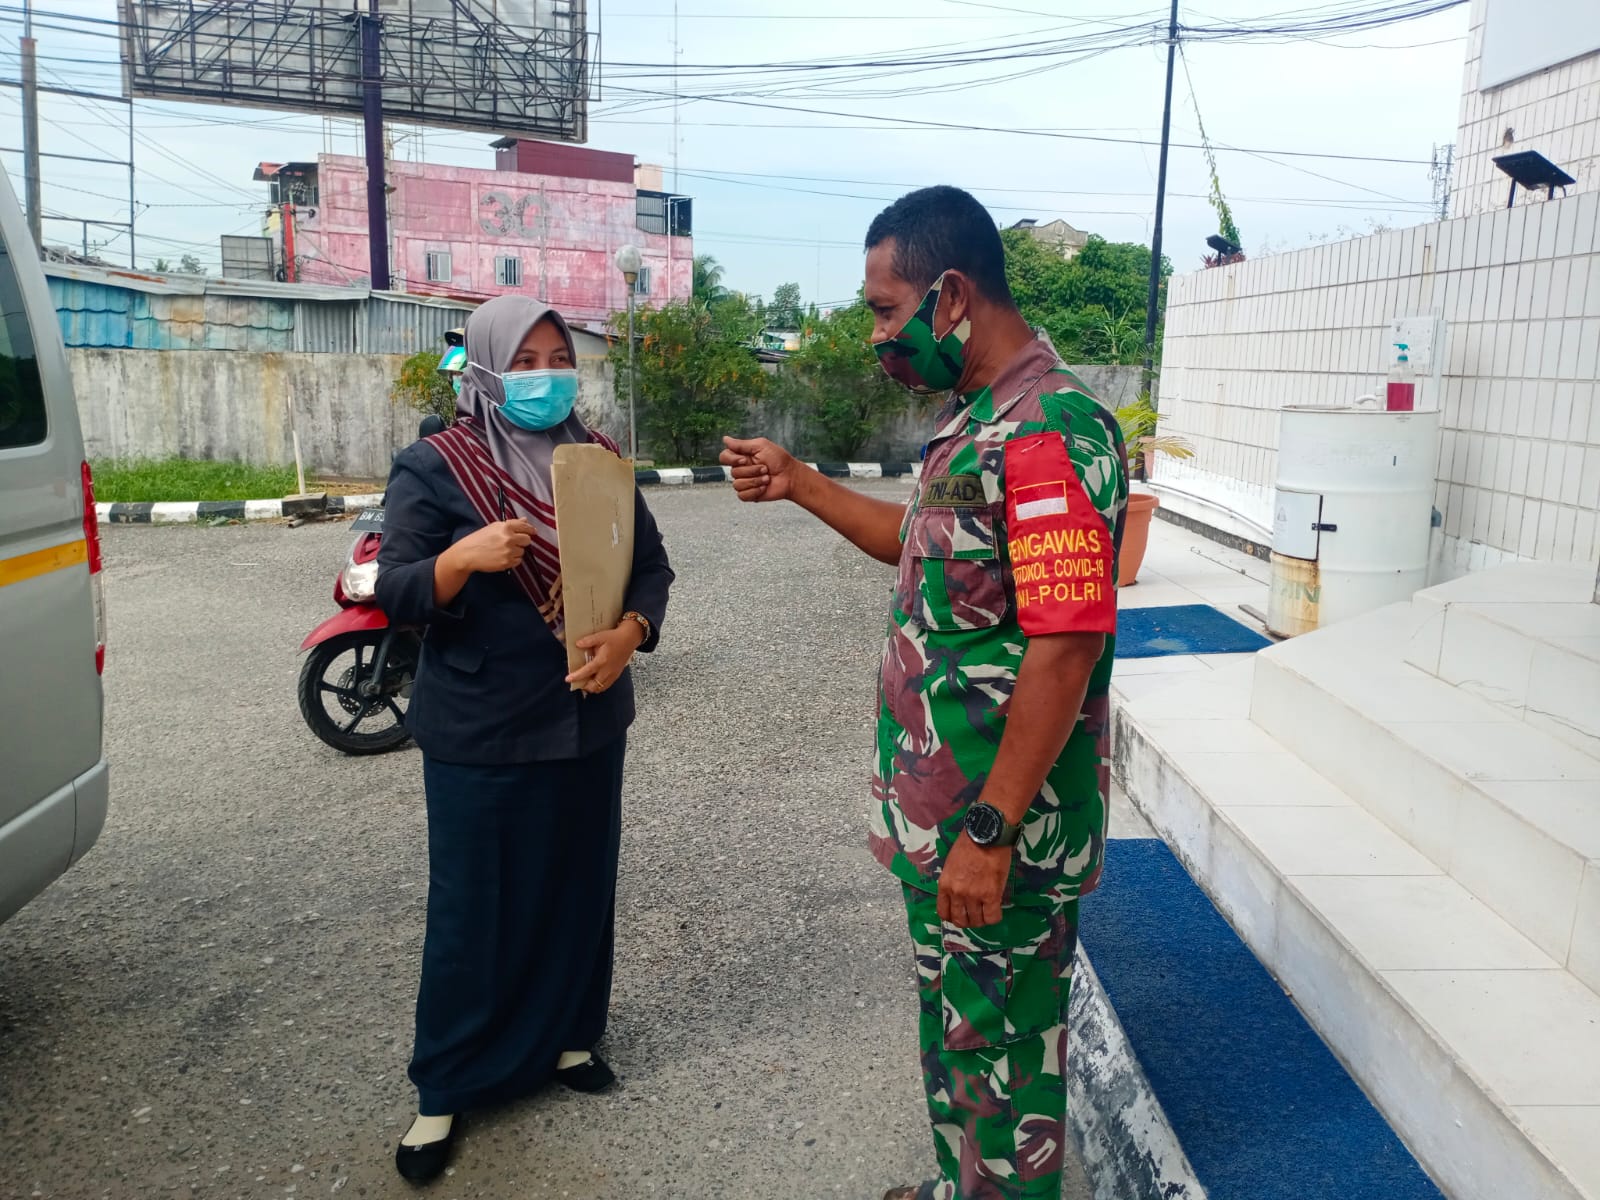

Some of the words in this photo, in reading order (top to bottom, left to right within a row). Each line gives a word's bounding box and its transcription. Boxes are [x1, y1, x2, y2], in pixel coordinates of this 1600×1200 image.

[478, 192, 550, 238] 3G
[927, 480, 977, 502] TNI-AD
[358, 511, 376, 521] BM
[1054, 558, 1104, 578] COVID-19
